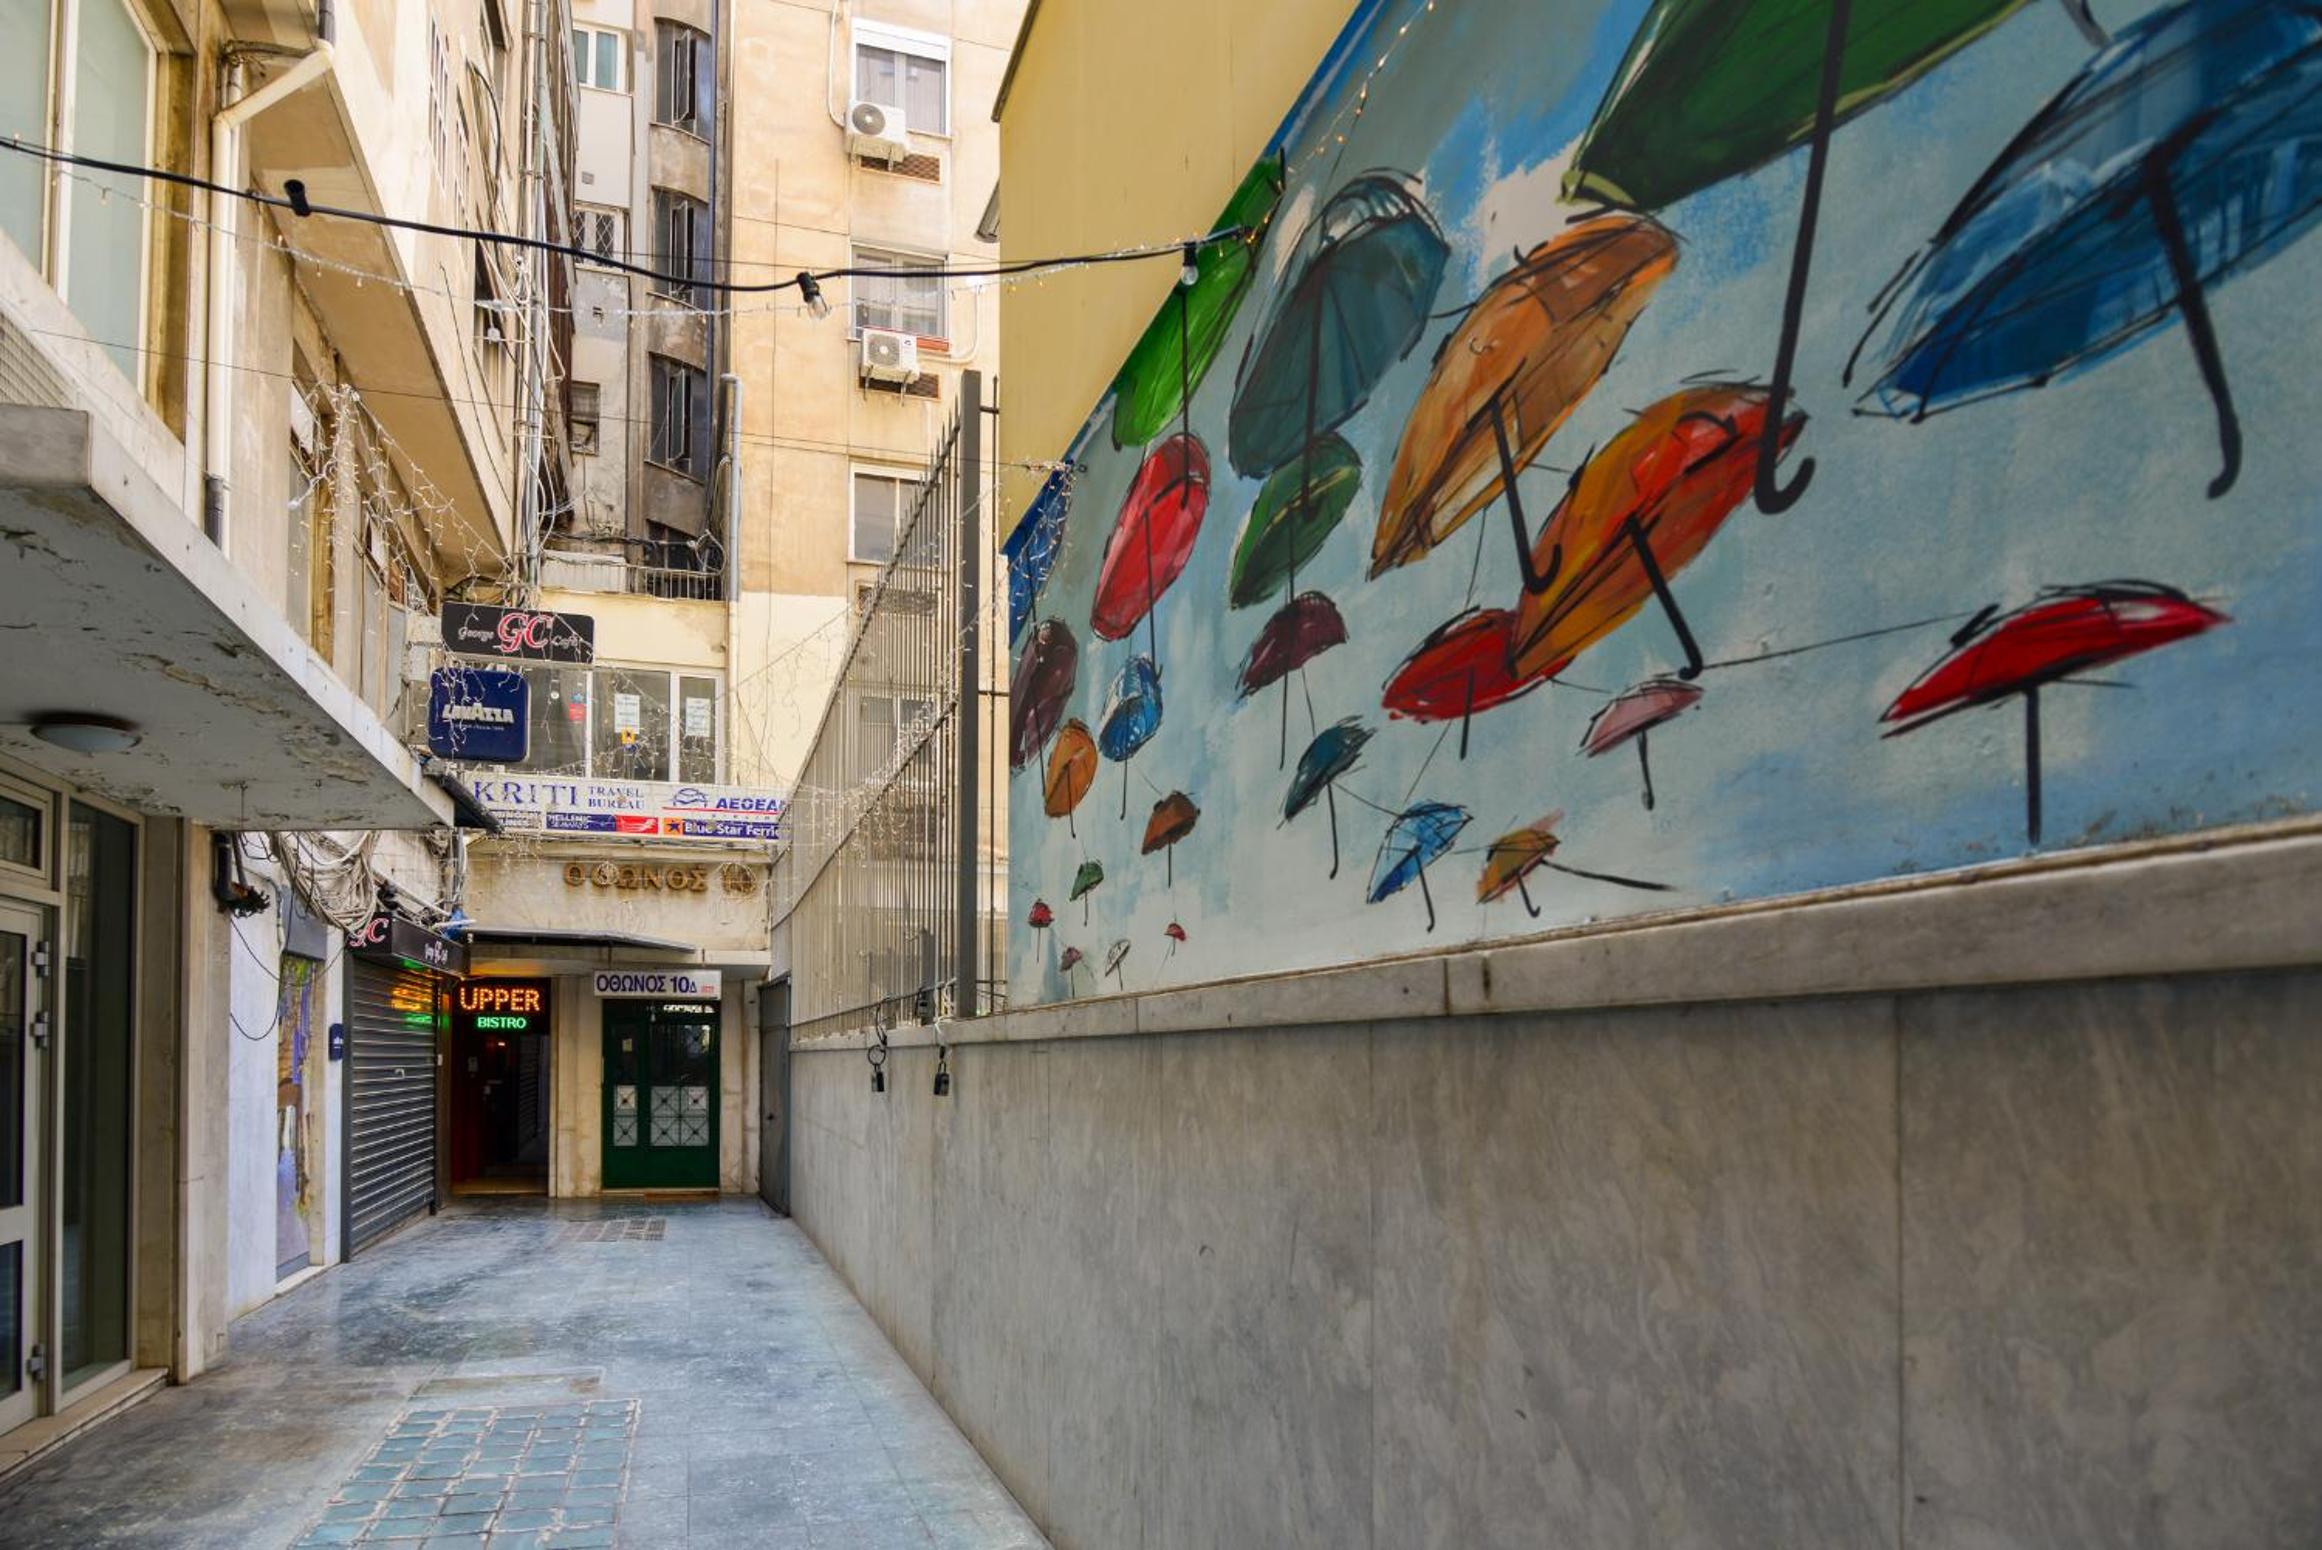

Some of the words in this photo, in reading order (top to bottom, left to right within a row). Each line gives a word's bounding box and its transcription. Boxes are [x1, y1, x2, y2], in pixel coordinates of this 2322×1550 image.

[473, 781, 577, 806] KRITI
[588, 786, 644, 798] TRAVEL
[588, 799, 645, 809] BUREAU
[716, 822, 742, 836] Star
[563, 861, 708, 892] ΟΘΩΝΟΣ
[597, 974, 666, 993] ΟΘΩΝΟΣ
[460, 986, 540, 1012] UPPER
[477, 1015, 527, 1029] BISTRO
